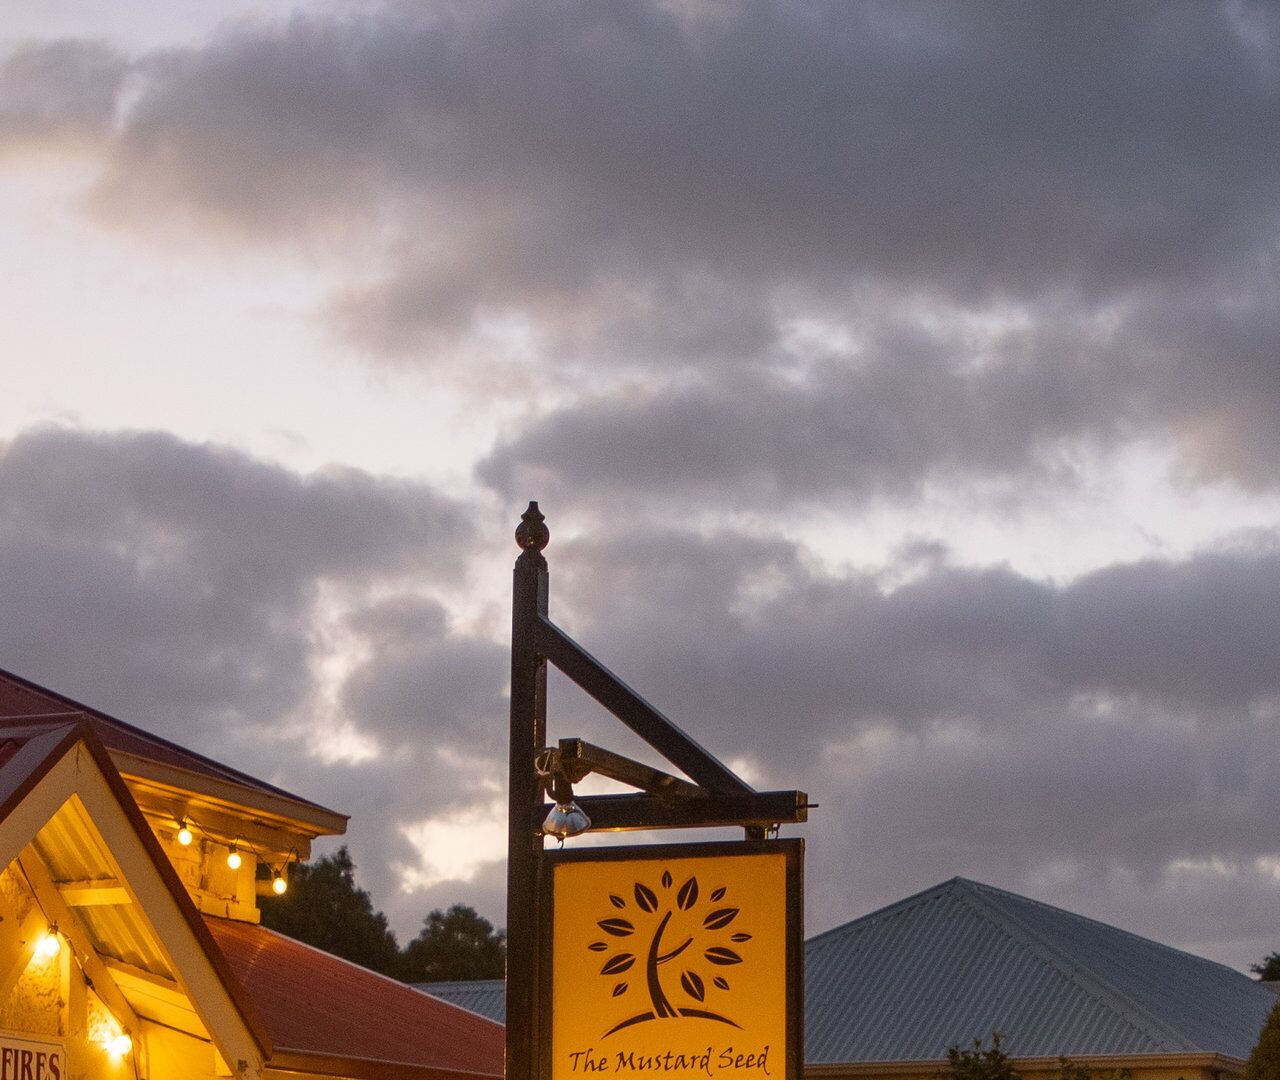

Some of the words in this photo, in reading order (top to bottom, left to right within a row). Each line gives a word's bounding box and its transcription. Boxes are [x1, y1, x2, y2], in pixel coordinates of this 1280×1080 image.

[570, 1048, 608, 1072] The
[615, 1047, 713, 1077] Mustard
[718, 1045, 770, 1075] Seed
